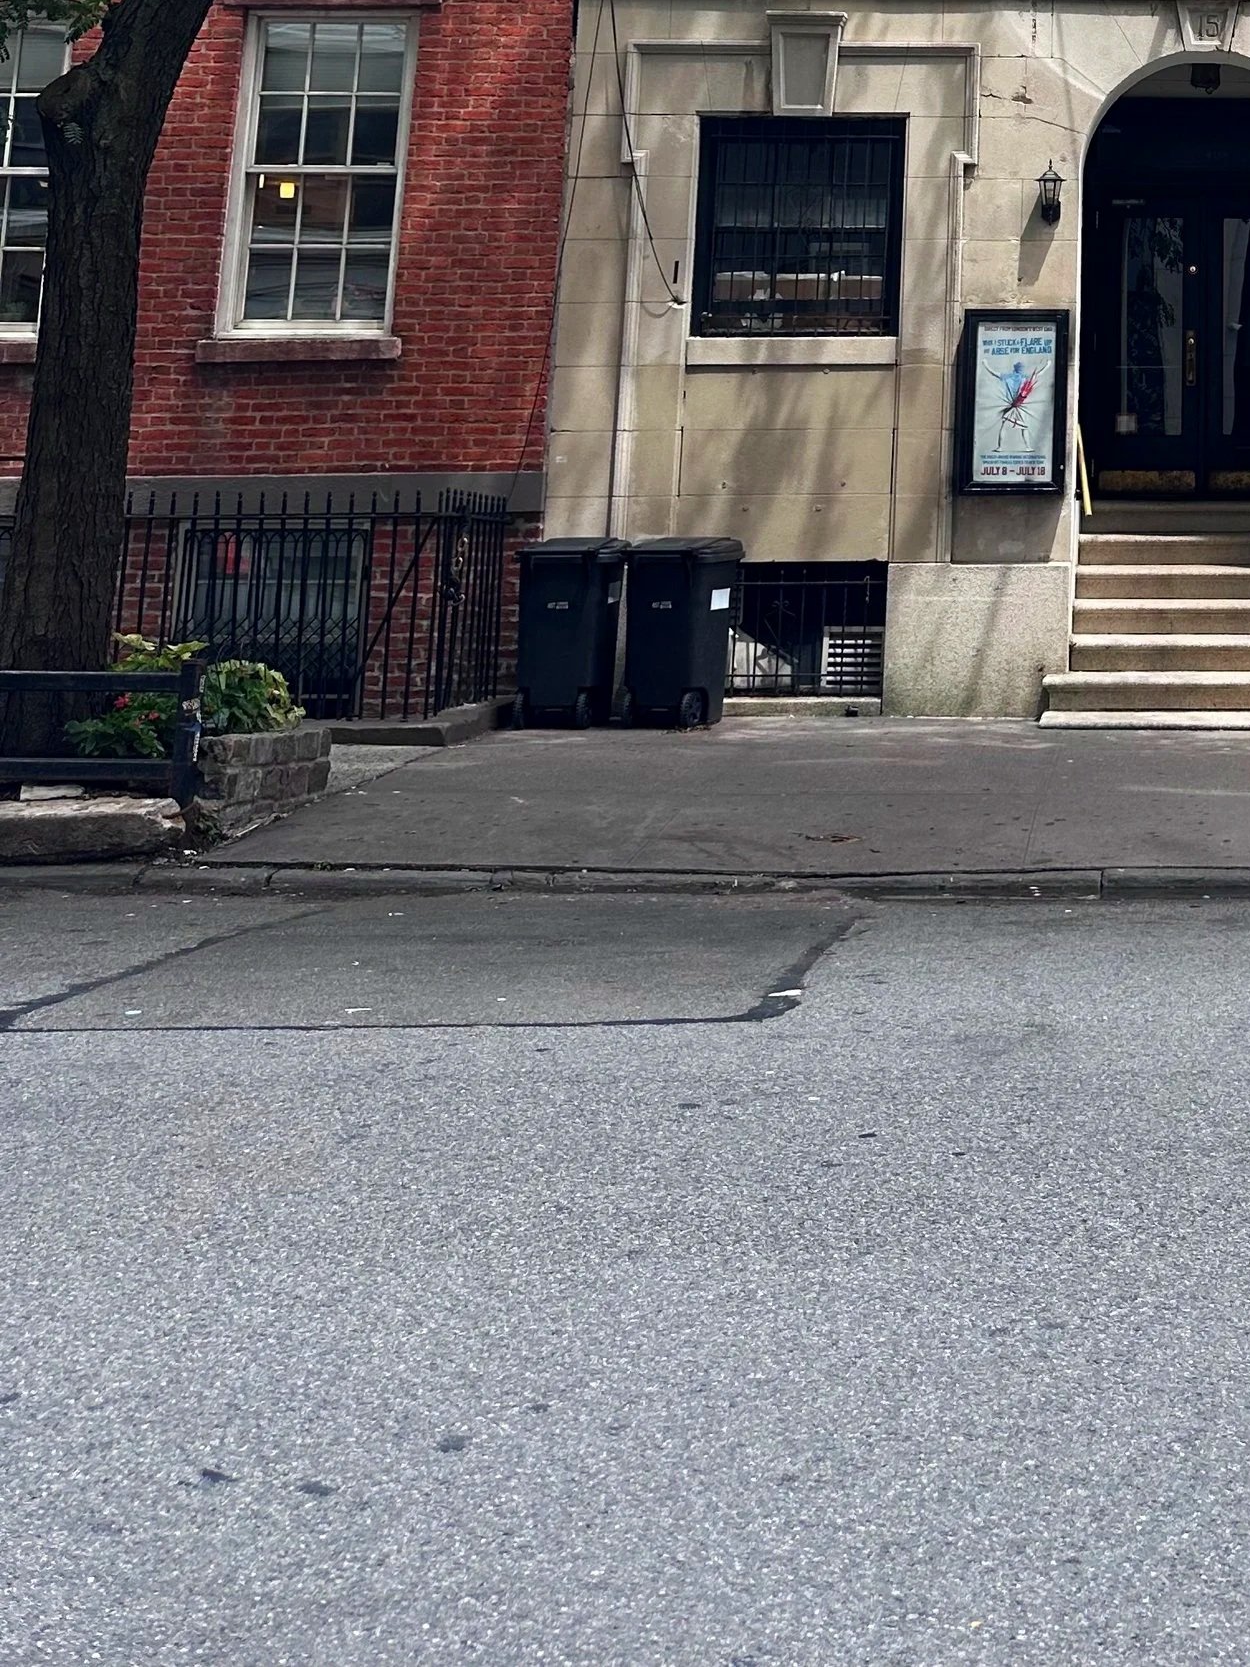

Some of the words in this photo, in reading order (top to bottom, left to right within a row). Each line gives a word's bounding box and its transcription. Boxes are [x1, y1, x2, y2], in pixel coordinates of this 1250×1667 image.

[1197, 15, 1219, 38] 15
[1020, 338, 1042, 347] FLARE
[992, 347, 1010, 355] ARSE
[1021, 346, 1052, 354] ENGLAND
[981, 467, 1000, 475] JULY
[1016, 467, 1036, 475] JULY
